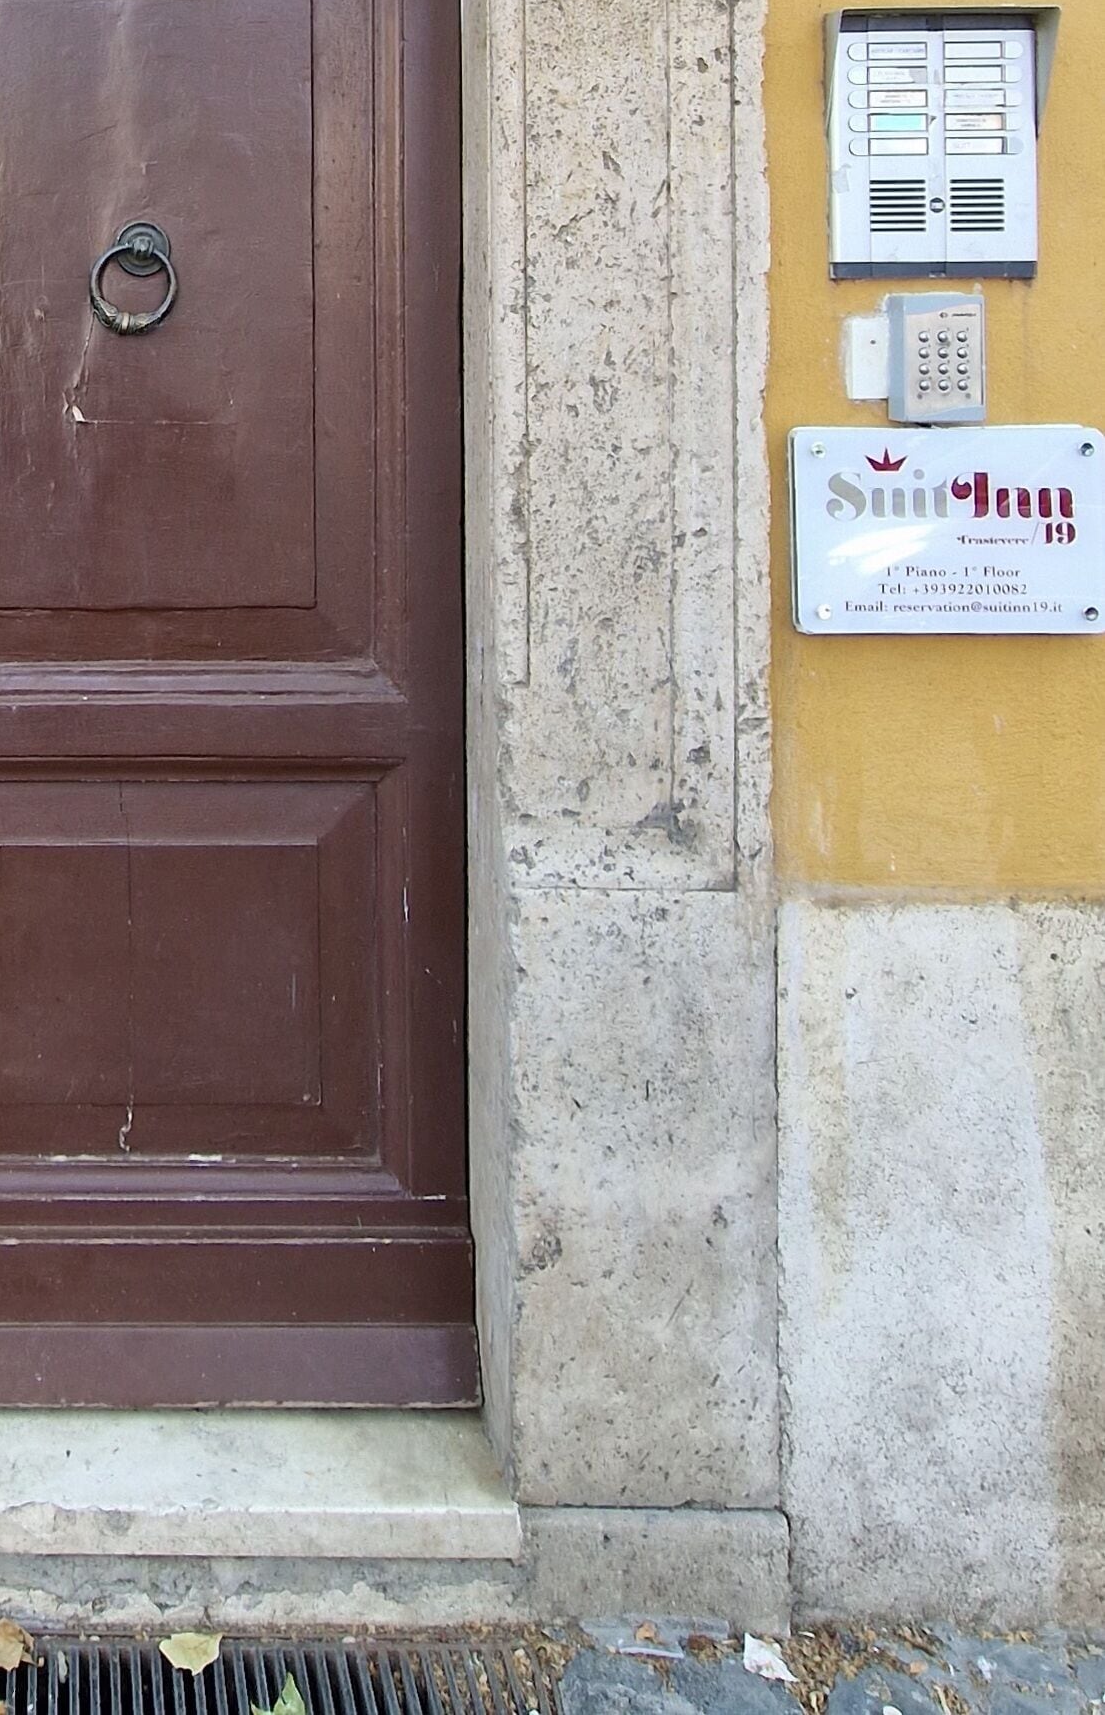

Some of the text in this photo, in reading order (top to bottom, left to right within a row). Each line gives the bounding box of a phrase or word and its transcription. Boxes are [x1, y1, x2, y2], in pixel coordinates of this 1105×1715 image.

[905, 565, 947, 577] Piano
[983, 565, 1022, 577] Floor
[878, 583, 1028, 595] Tel: +393922010082
[845, 600, 1063, 614] Email: reservation@suitinn19.it
